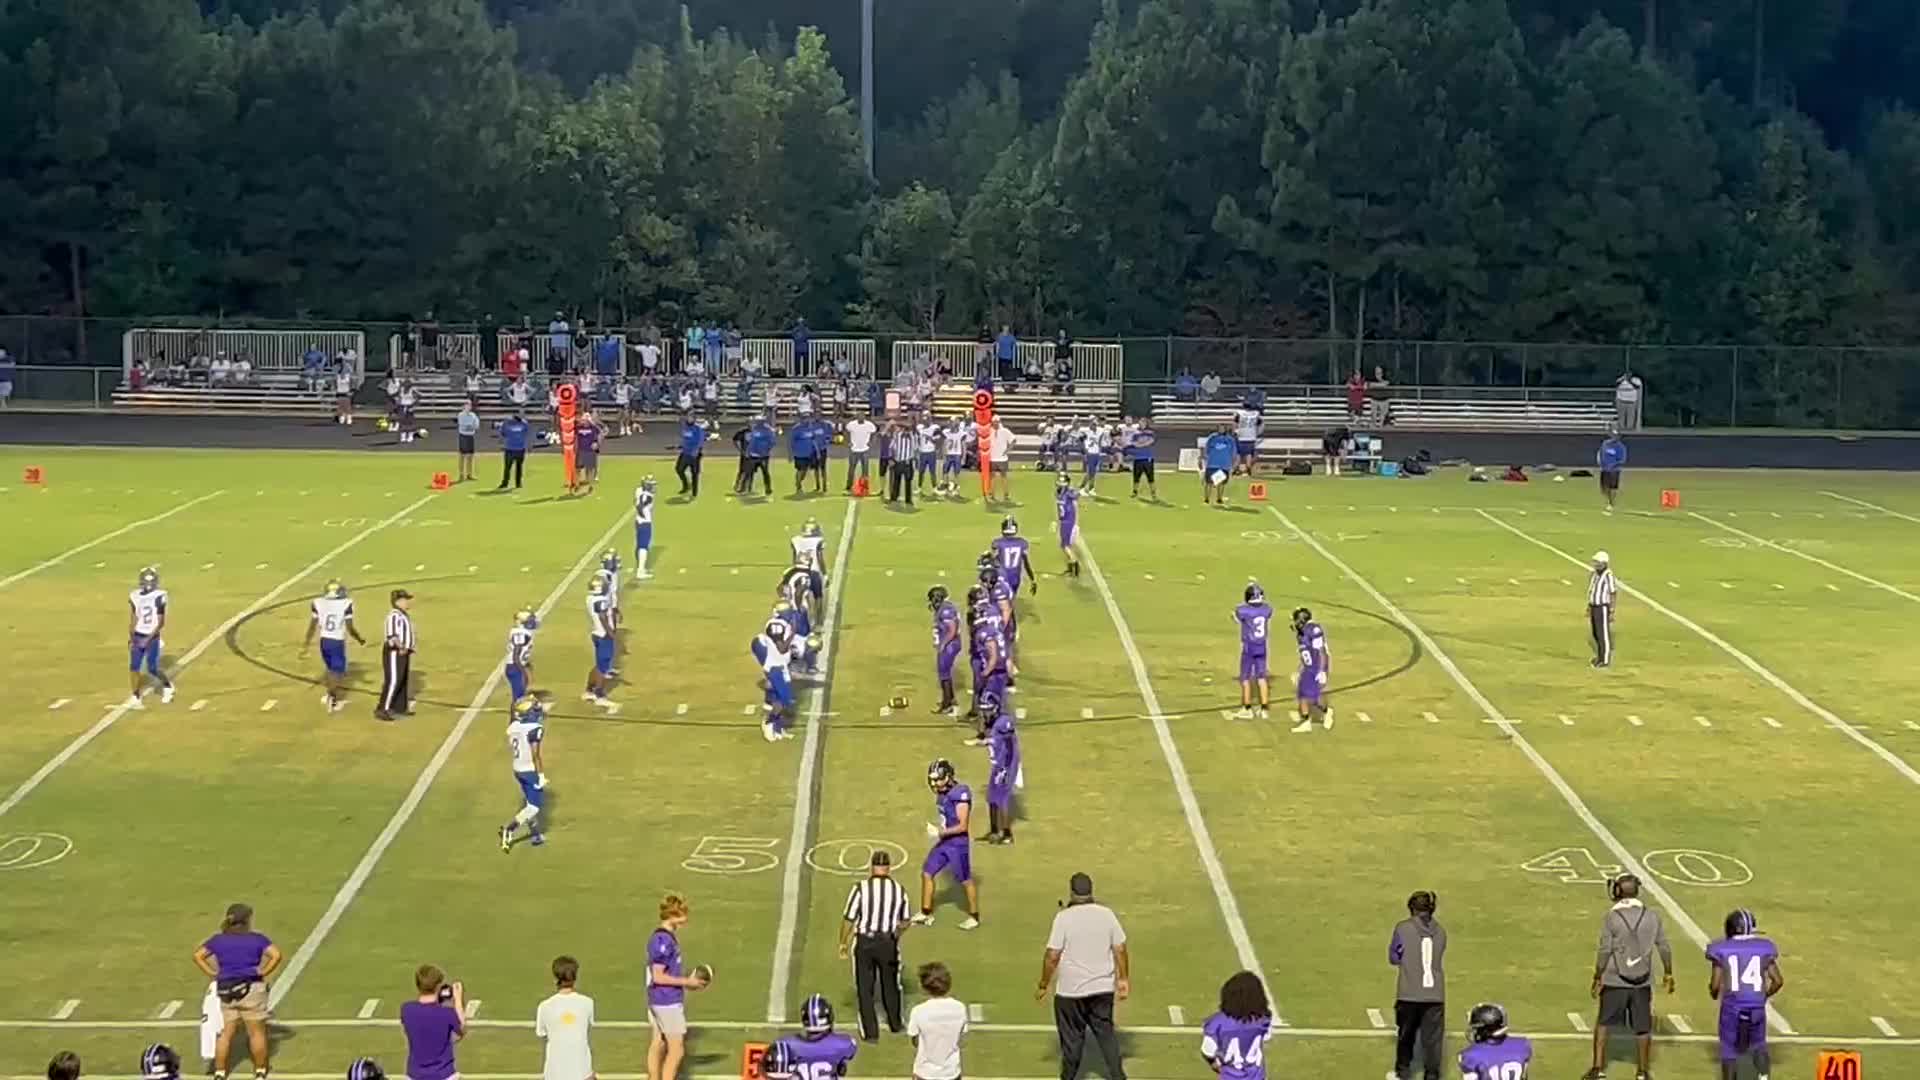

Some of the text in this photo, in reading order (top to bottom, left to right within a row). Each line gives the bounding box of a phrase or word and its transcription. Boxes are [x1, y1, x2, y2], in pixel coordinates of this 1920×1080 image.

[1004, 546, 1021, 568] 17
[142, 605, 153, 624] 2
[325, 614, 336, 632] 6
[1253, 616, 1266, 638] 3
[1421, 937, 1434, 988] 1
[1728, 955, 1763, 992] 14
[1224, 1034, 1263, 1069] 44
[1824, 1055, 1857, 1080] 40
